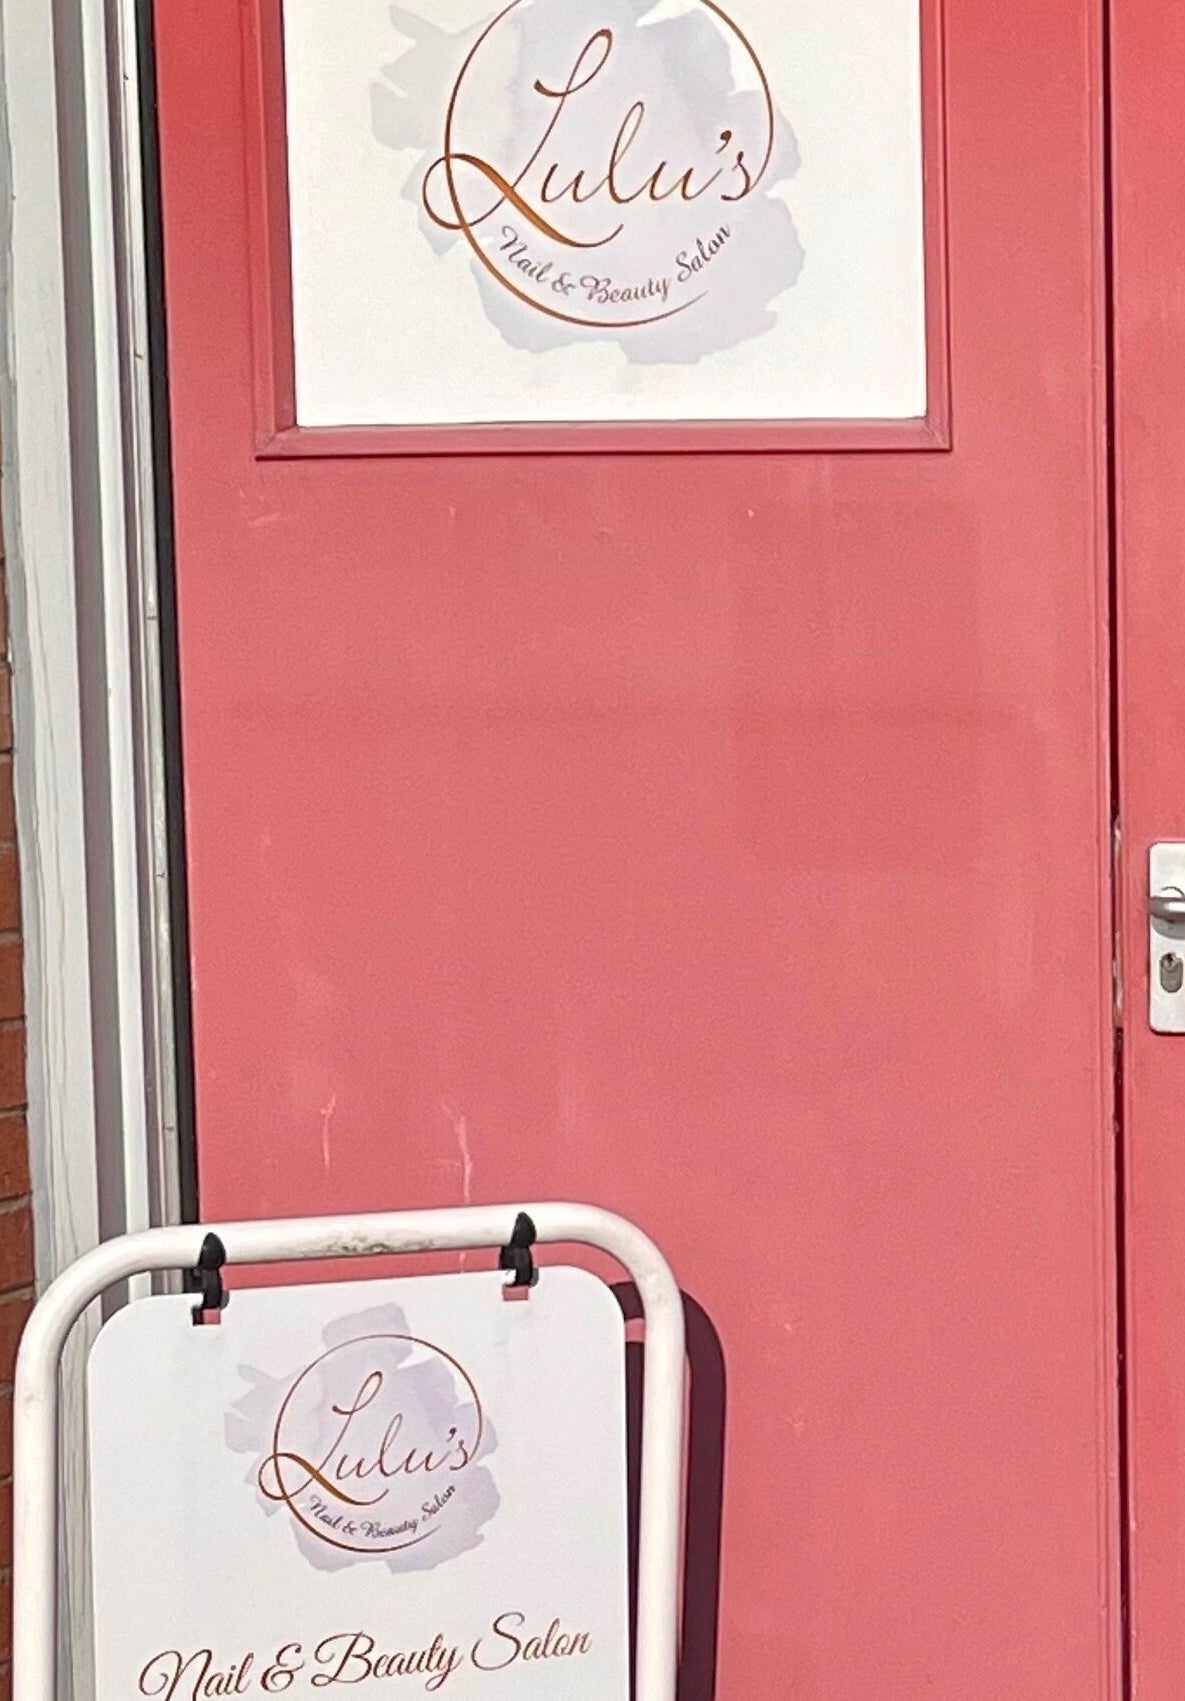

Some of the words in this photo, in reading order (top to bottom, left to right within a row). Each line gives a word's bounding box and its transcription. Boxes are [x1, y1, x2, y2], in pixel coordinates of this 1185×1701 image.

[423, 28, 754, 248] Lulu's
[499, 225, 553, 283] Nail
[551, 272, 577, 296] &
[579, 274, 672, 304] Beauty
[676, 222, 732, 283] Salon
[258, 1370, 467, 1506] Lulu's
[139, 1649, 254, 1701] Nail
[260, 1642, 305, 1692] &
[310, 1631, 464, 1692] Beauty
[471, 1611, 593, 1671] Salon
